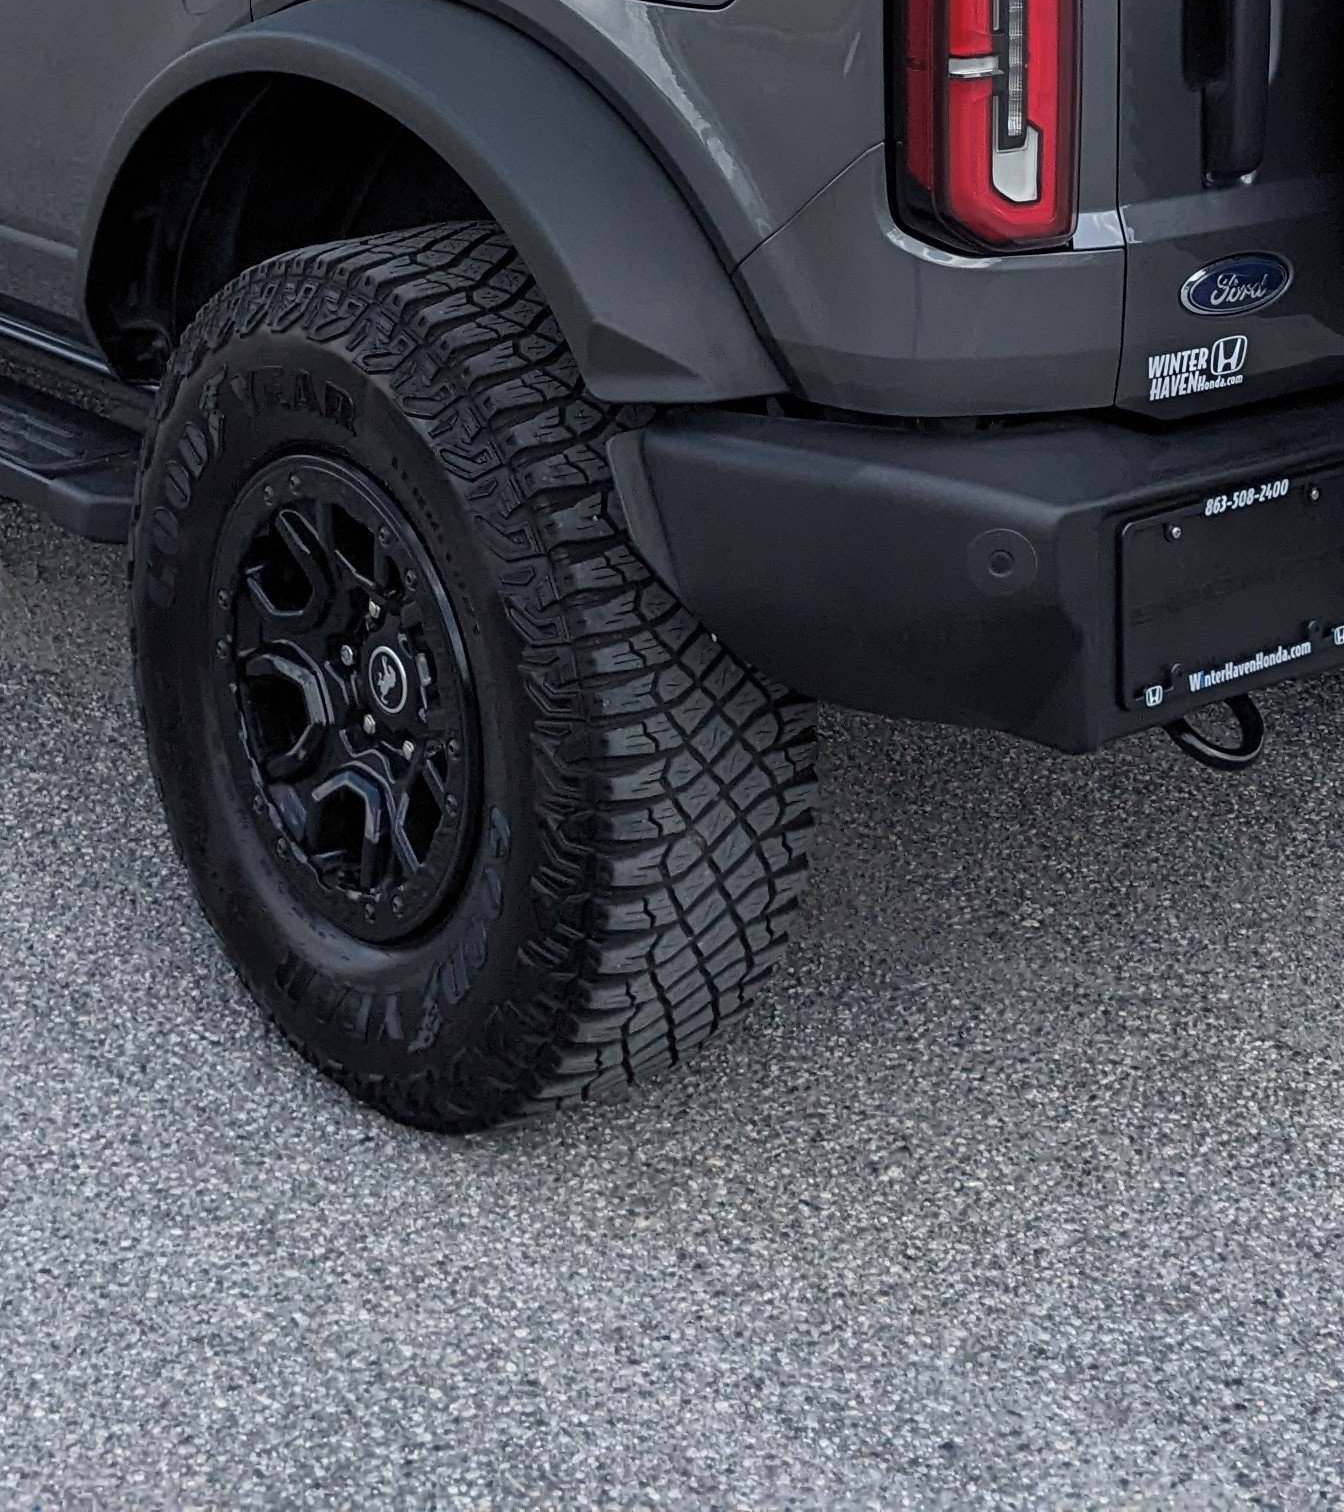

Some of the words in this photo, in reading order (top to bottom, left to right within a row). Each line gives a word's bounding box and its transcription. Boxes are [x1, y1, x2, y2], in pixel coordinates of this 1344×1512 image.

[1210, 273, 1269, 306] Ford
[1148, 347, 1209, 379] WINTER
[1204, 478, 1289, 516] 863-508-2400
[1188, 641, 1312, 692] WinterHavenHonda.com
